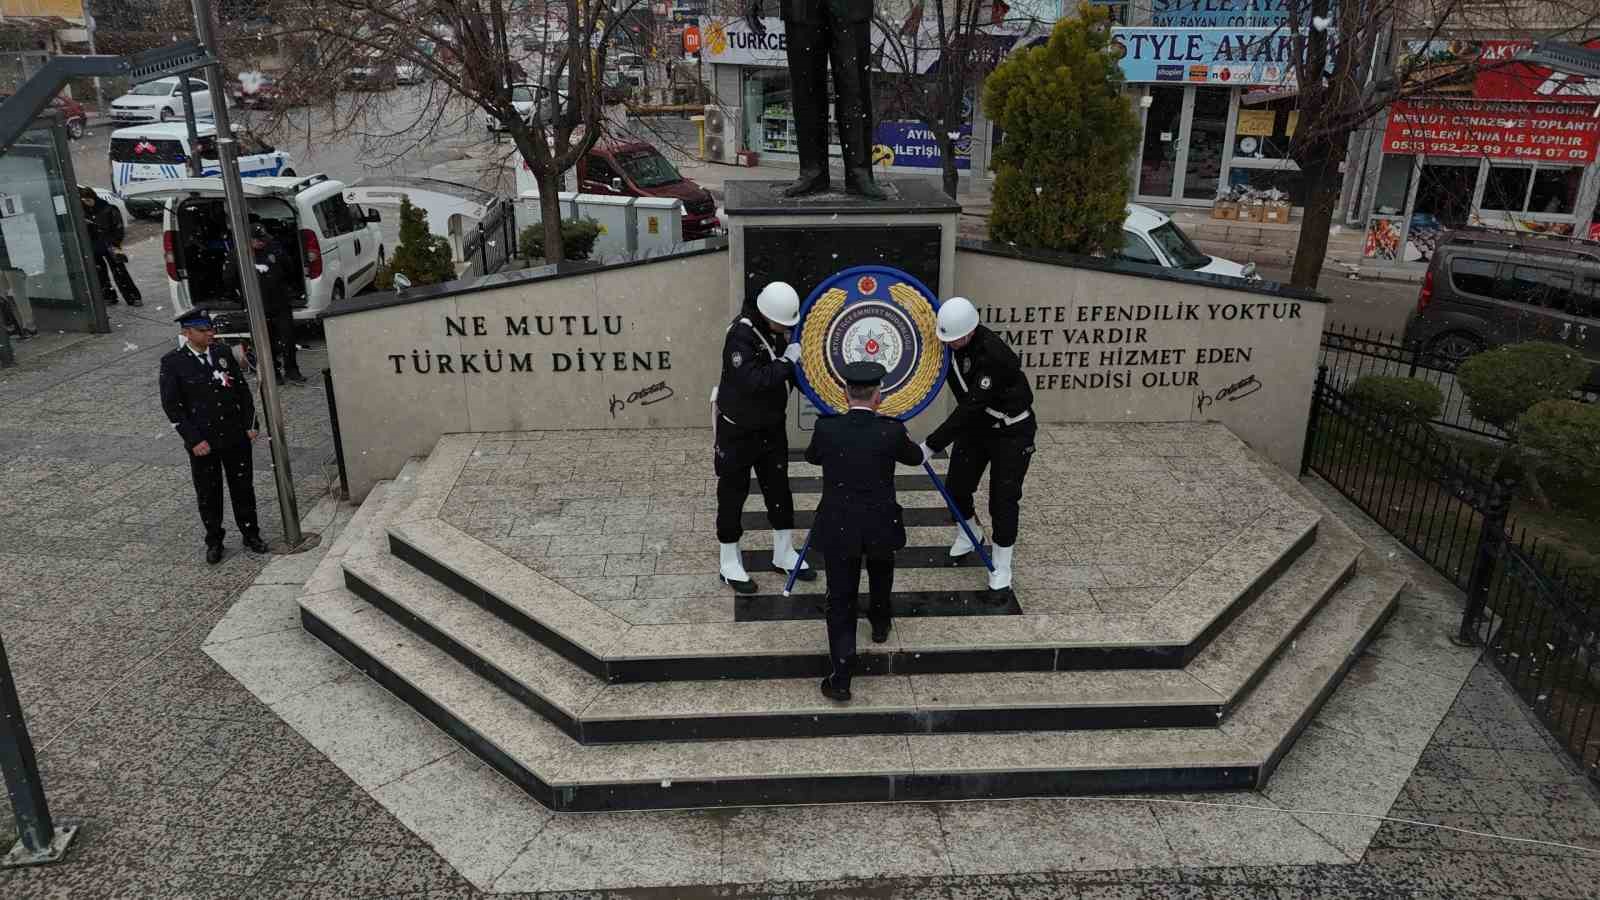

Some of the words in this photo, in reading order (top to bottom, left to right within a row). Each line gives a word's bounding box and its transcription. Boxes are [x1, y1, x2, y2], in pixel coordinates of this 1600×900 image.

[726, 31, 788, 51] TURKCE
[1112, 34, 1205, 62] STYLE
[1530, 134, 1583, 146] YAPILIR
[894, 144, 941, 158] İLETİŞİ
[1207, 302, 1303, 321] YOKTUR
[445, 315, 489, 337] NE
[505, 315, 624, 337] MUTLU
[1062, 327, 1148, 345] VARDIR
[388, 348, 535, 375] TÜRKÜM
[551, 347, 673, 373] DİYENE
[1017, 349, 1091, 368] İLLETE
[1099, 346, 1186, 367] HİZMET
[1195, 346, 1253, 365] EDEN
[1035, 369, 1132, 391] EFENDİSİ
[1141, 370, 1200, 389] OLUR
